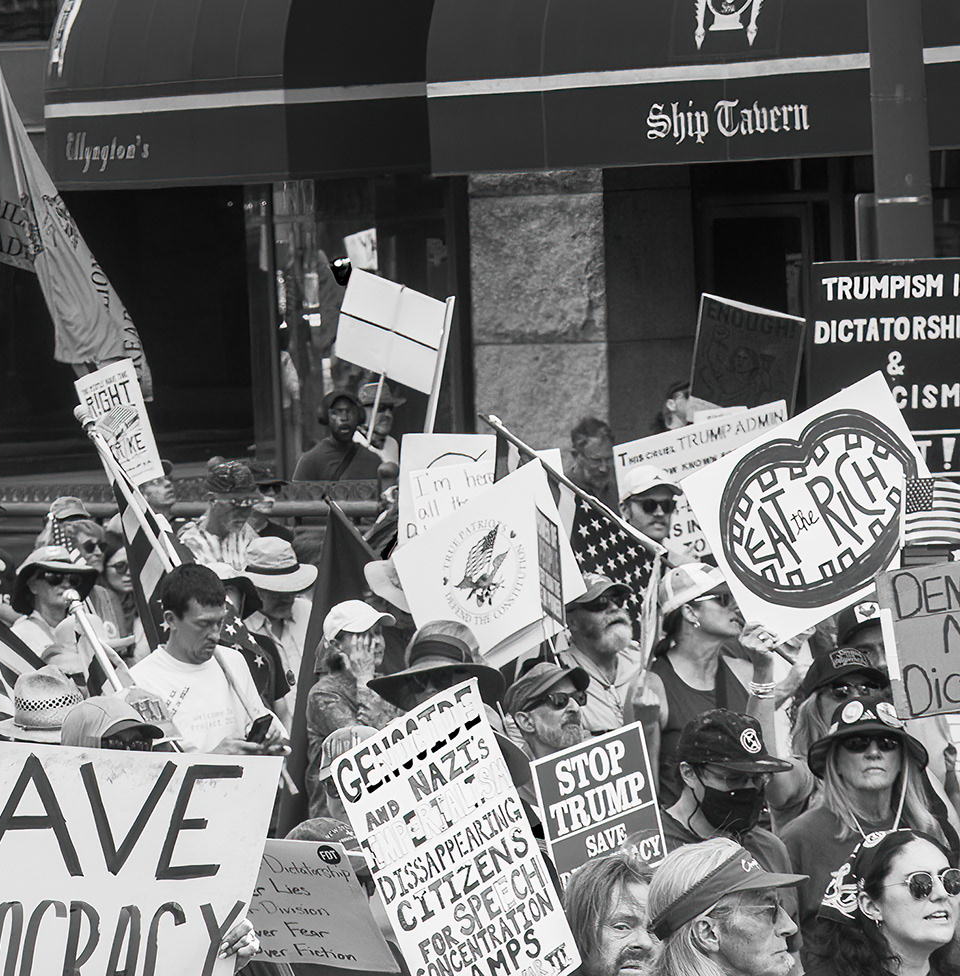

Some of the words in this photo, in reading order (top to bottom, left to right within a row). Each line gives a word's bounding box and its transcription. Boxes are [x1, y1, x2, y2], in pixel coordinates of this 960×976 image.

[646, 100, 709, 145] Ship
[713, 99, 810, 137] Tavern
[822, 274, 944, 301] TRUMPISM
[886, 351, 906, 376] &
[677, 423, 732, 451] TRUMP
[734, 408, 785, 436] ADMIN
[418, 499, 440, 520] all
[805, 451, 889, 547] RICH
[744, 487, 802, 569] EAT
[791, 508, 820, 536] the
[336, 686, 482, 804] GENOCIDE
[554, 739, 626, 796] STOP
[364, 799, 400, 832] AND
[548, 771, 646, 837] TRUMP
[319, 850, 338, 862] FDT
[376, 797, 523, 905] DISSAPPEARING
[585, 822, 628, 858] SAVE
[262, 854, 351, 884] Dictatorship
[396, 826, 530, 932] CITIZENS
[268, 877, 311, 897] Lies
[262, 900, 330, 917] Division
[284, 921, 330, 939] Fear
[418, 925, 460, 965] FOR
[293, 943, 358, 962] Fiction
